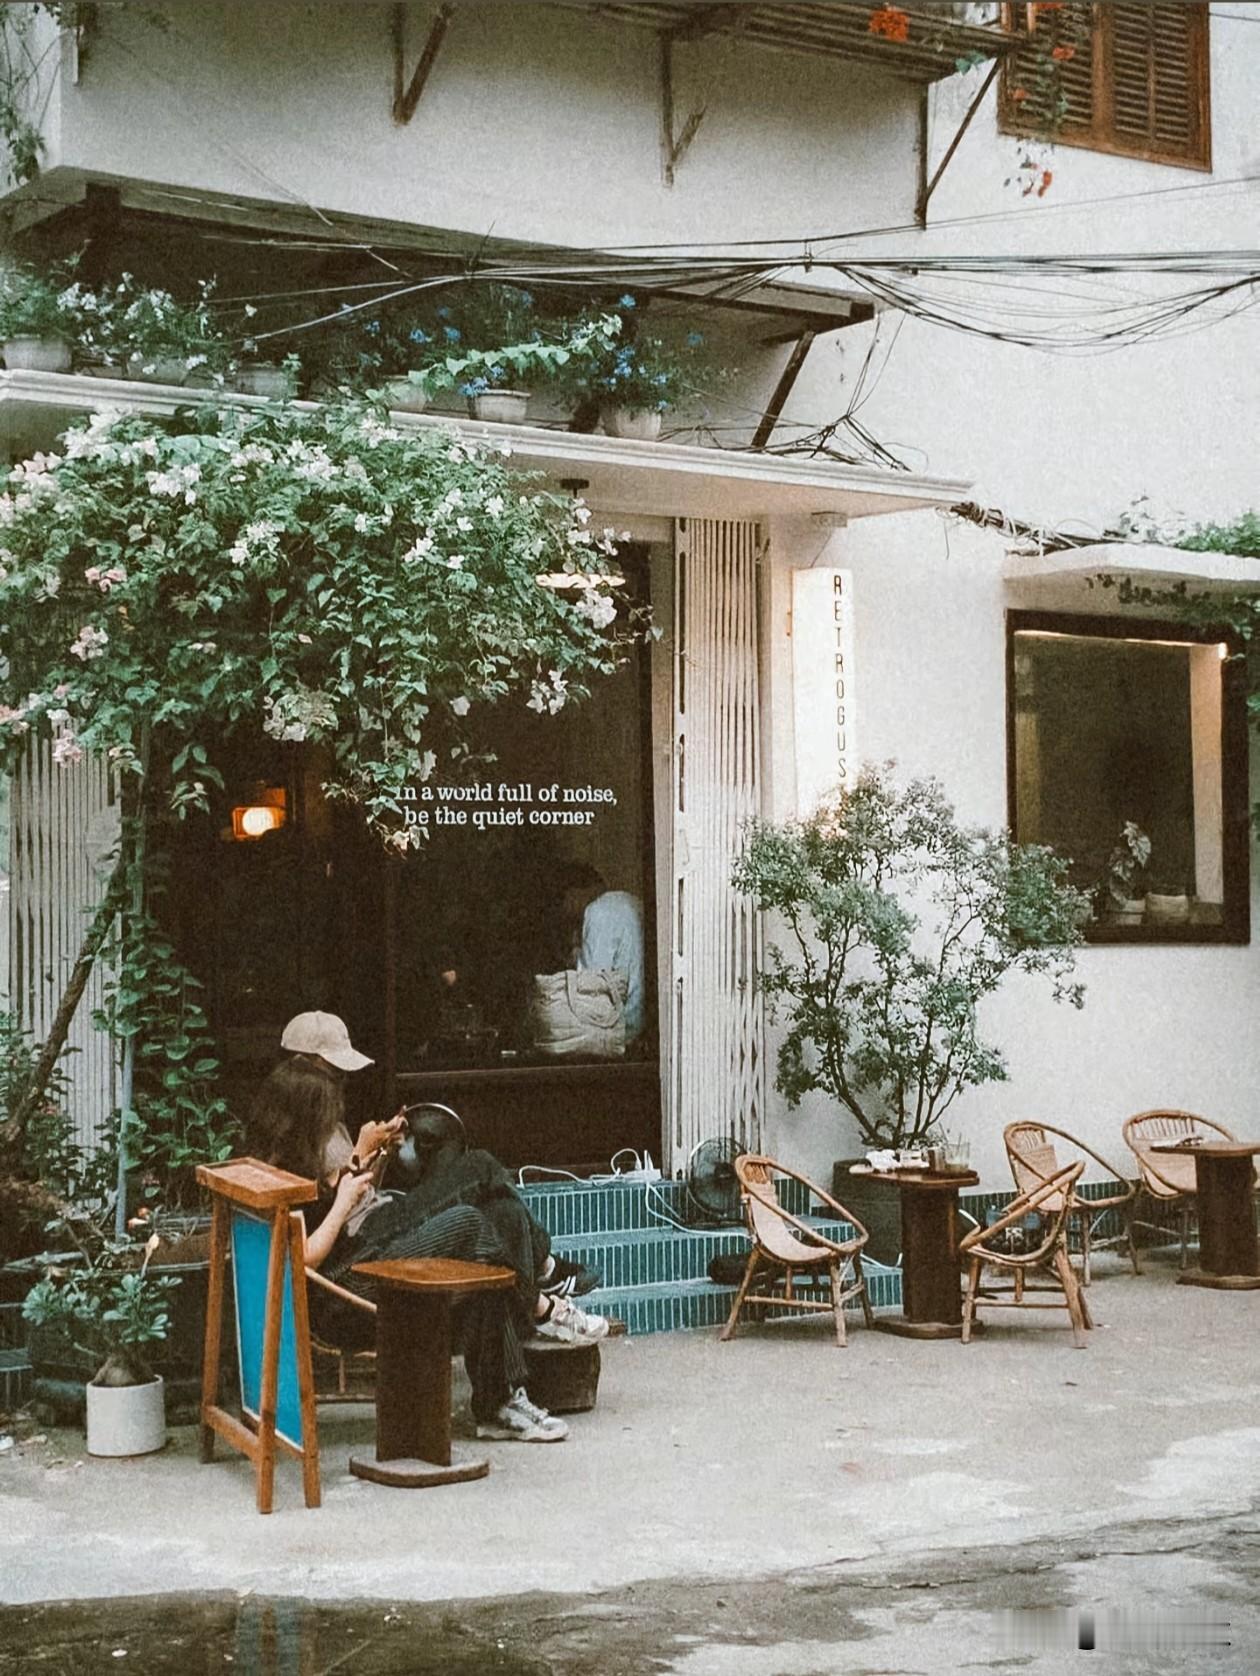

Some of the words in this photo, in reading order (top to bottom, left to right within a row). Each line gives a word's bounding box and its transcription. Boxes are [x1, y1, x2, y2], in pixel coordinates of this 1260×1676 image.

[833, 574, 847, 778] RETROGUS
[421, 786, 434, 800] a
[436, 783, 493, 801] world
[498, 784, 533, 802] full
[538, 784, 559, 802] of
[562, 785, 618, 806] noise,
[403, 805, 429, 825] be
[435, 806, 467, 825] the
[472, 808, 524, 831] quiet
[529, 810, 595, 826] corner
